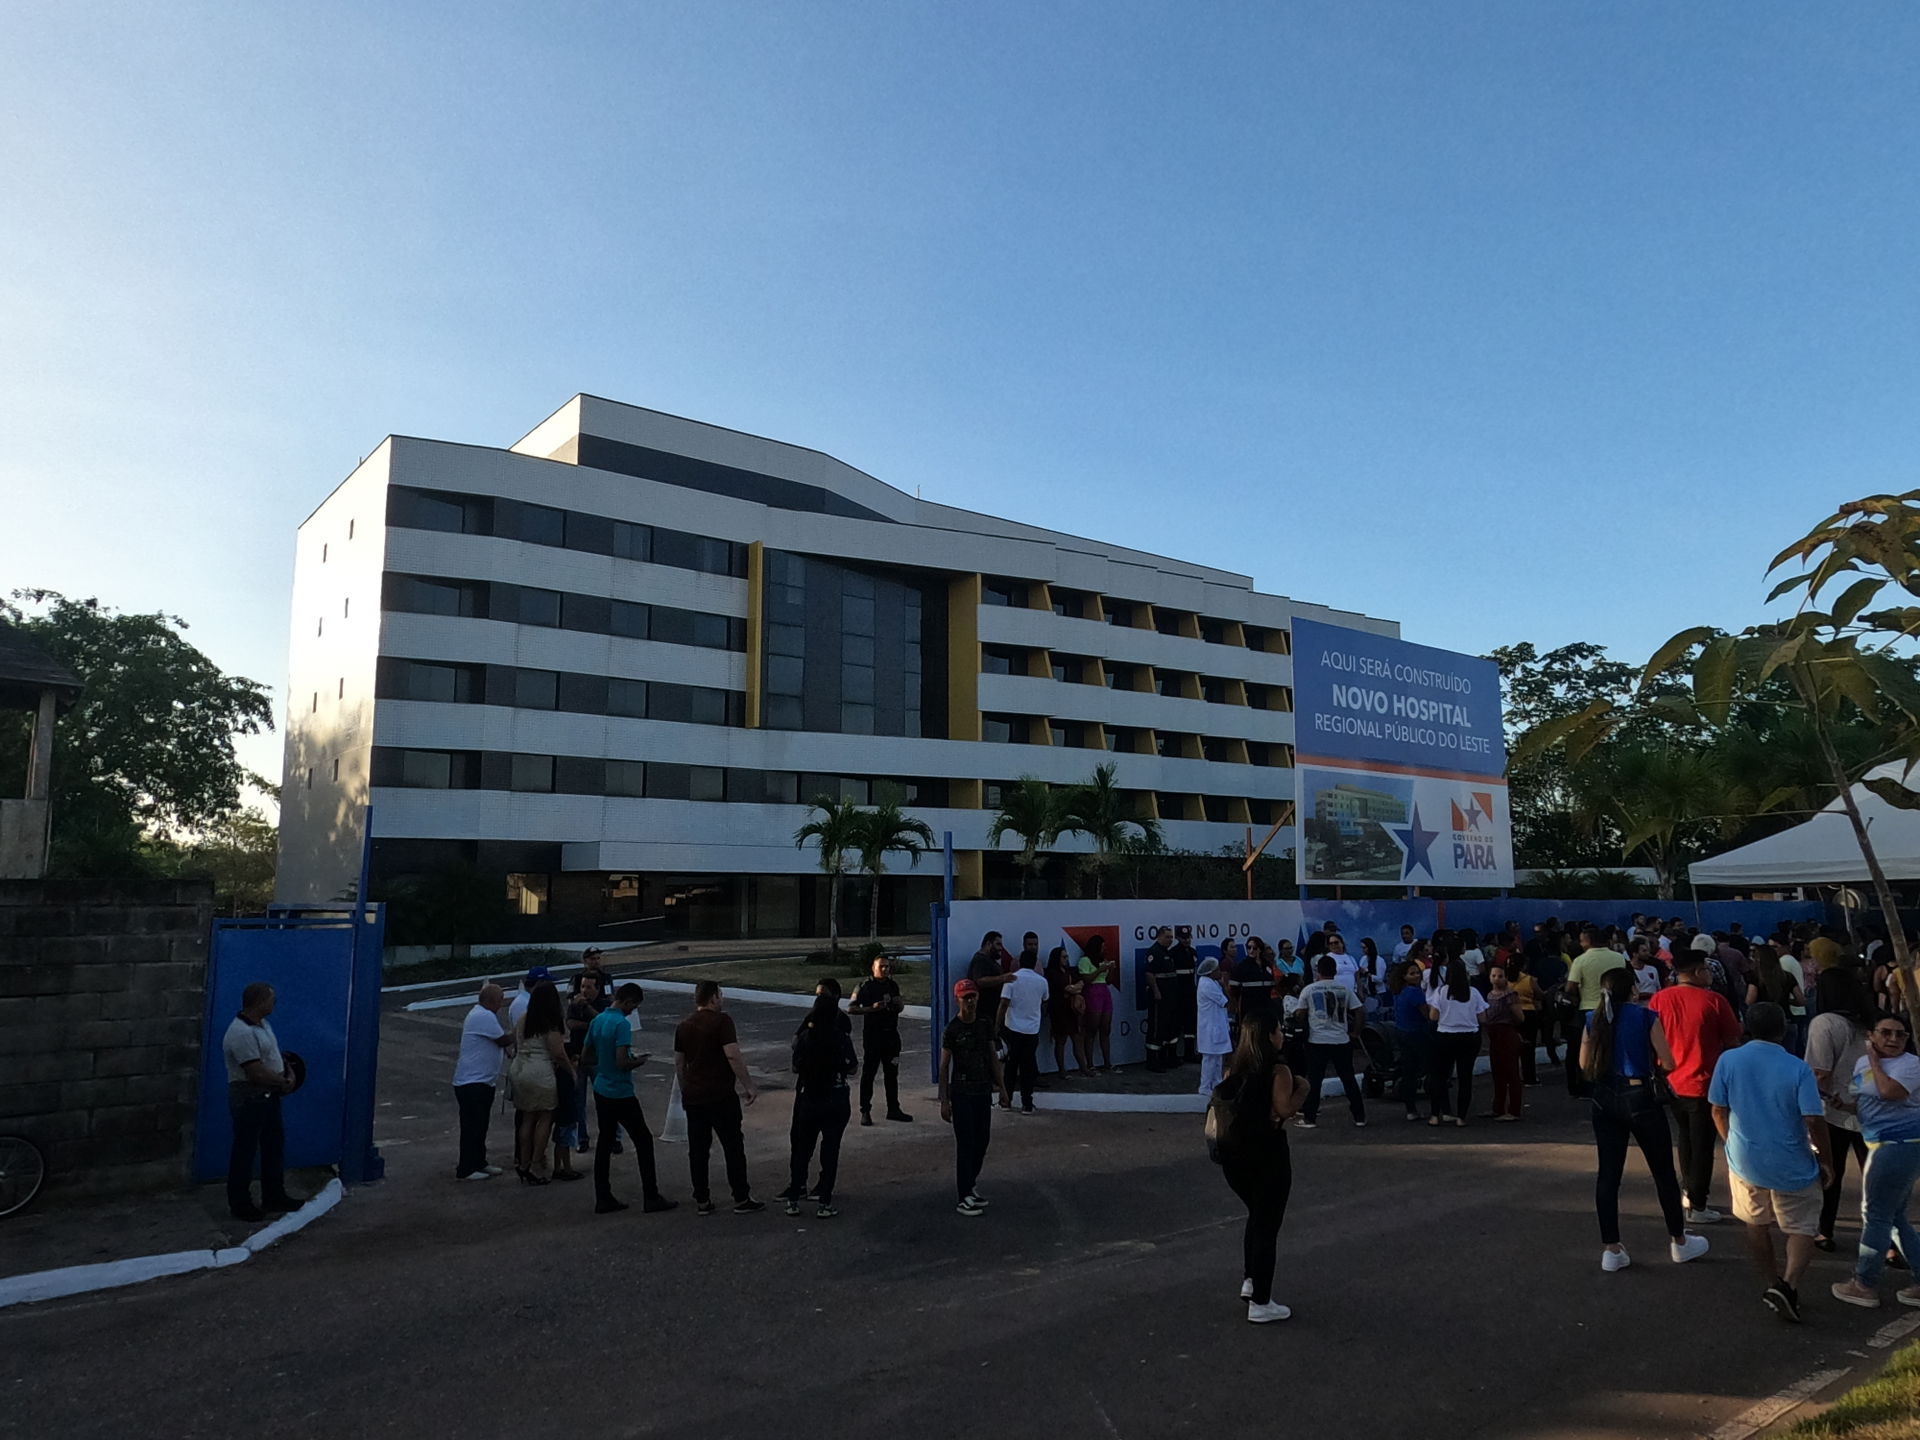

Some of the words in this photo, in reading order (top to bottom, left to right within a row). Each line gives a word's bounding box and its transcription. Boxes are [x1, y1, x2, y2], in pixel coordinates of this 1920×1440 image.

[1320, 650, 1356, 672] AQUI
[1359, 657, 1392, 680] SERÁ
[1394, 664, 1472, 695] CONSTRUÍDO
[1332, 683, 1389, 715] NOVO
[1392, 694, 1472, 728] HOSPITAL
[1315, 713, 1382, 739] REGIONAL
[1385, 720, 1436, 747] PÚBLICO
[1438, 731, 1458, 749] DO
[1460, 734, 1491, 754] LESTE
[1134, 924, 1219, 941] GONO
[1228, 923, 1250, 937] DO
